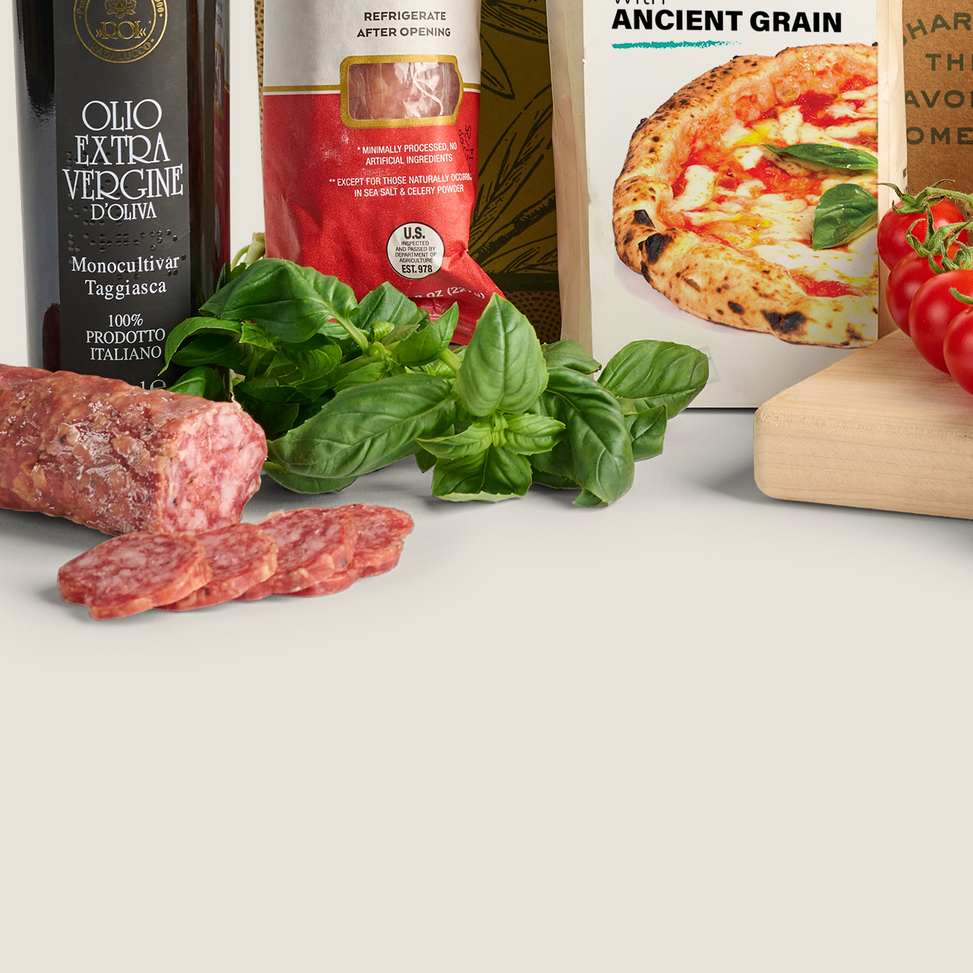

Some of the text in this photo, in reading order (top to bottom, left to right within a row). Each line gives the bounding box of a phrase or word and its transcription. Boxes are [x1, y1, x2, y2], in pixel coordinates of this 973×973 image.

[363, 11, 447, 22] REFRIGERATE
[611, 9, 842, 33] ANCIENT GRAIN
[356, 27, 451, 38] AFTER OPENING
[81, 98, 162, 132] OLIO
[74, 131, 170, 167] EXTRA
[362, 142, 458, 155] MINIMALLY PROCESSED, NO
[365, 153, 453, 166] ARTIFICIAL INGREDIENTS
[61, 163, 183, 201] VERGINE
[337, 174, 449, 187] EXCEPT FOR THOSE NATURALLY
[354, 184, 464, 197] IN SEA SALT & CELERY POWDER
[90, 201, 157, 221] D'OLIVA
[403, 226, 426, 240] U.S.
[71, 255, 180, 274] Monocultivar
[401, 264, 433, 274] EST. 978
[84, 279, 167, 300] Taggiasca
[108, 313, 144, 327] 100%
[85, 328, 166, 344] PRODOTTO
[90, 345, 162, 361] ITALIANO
